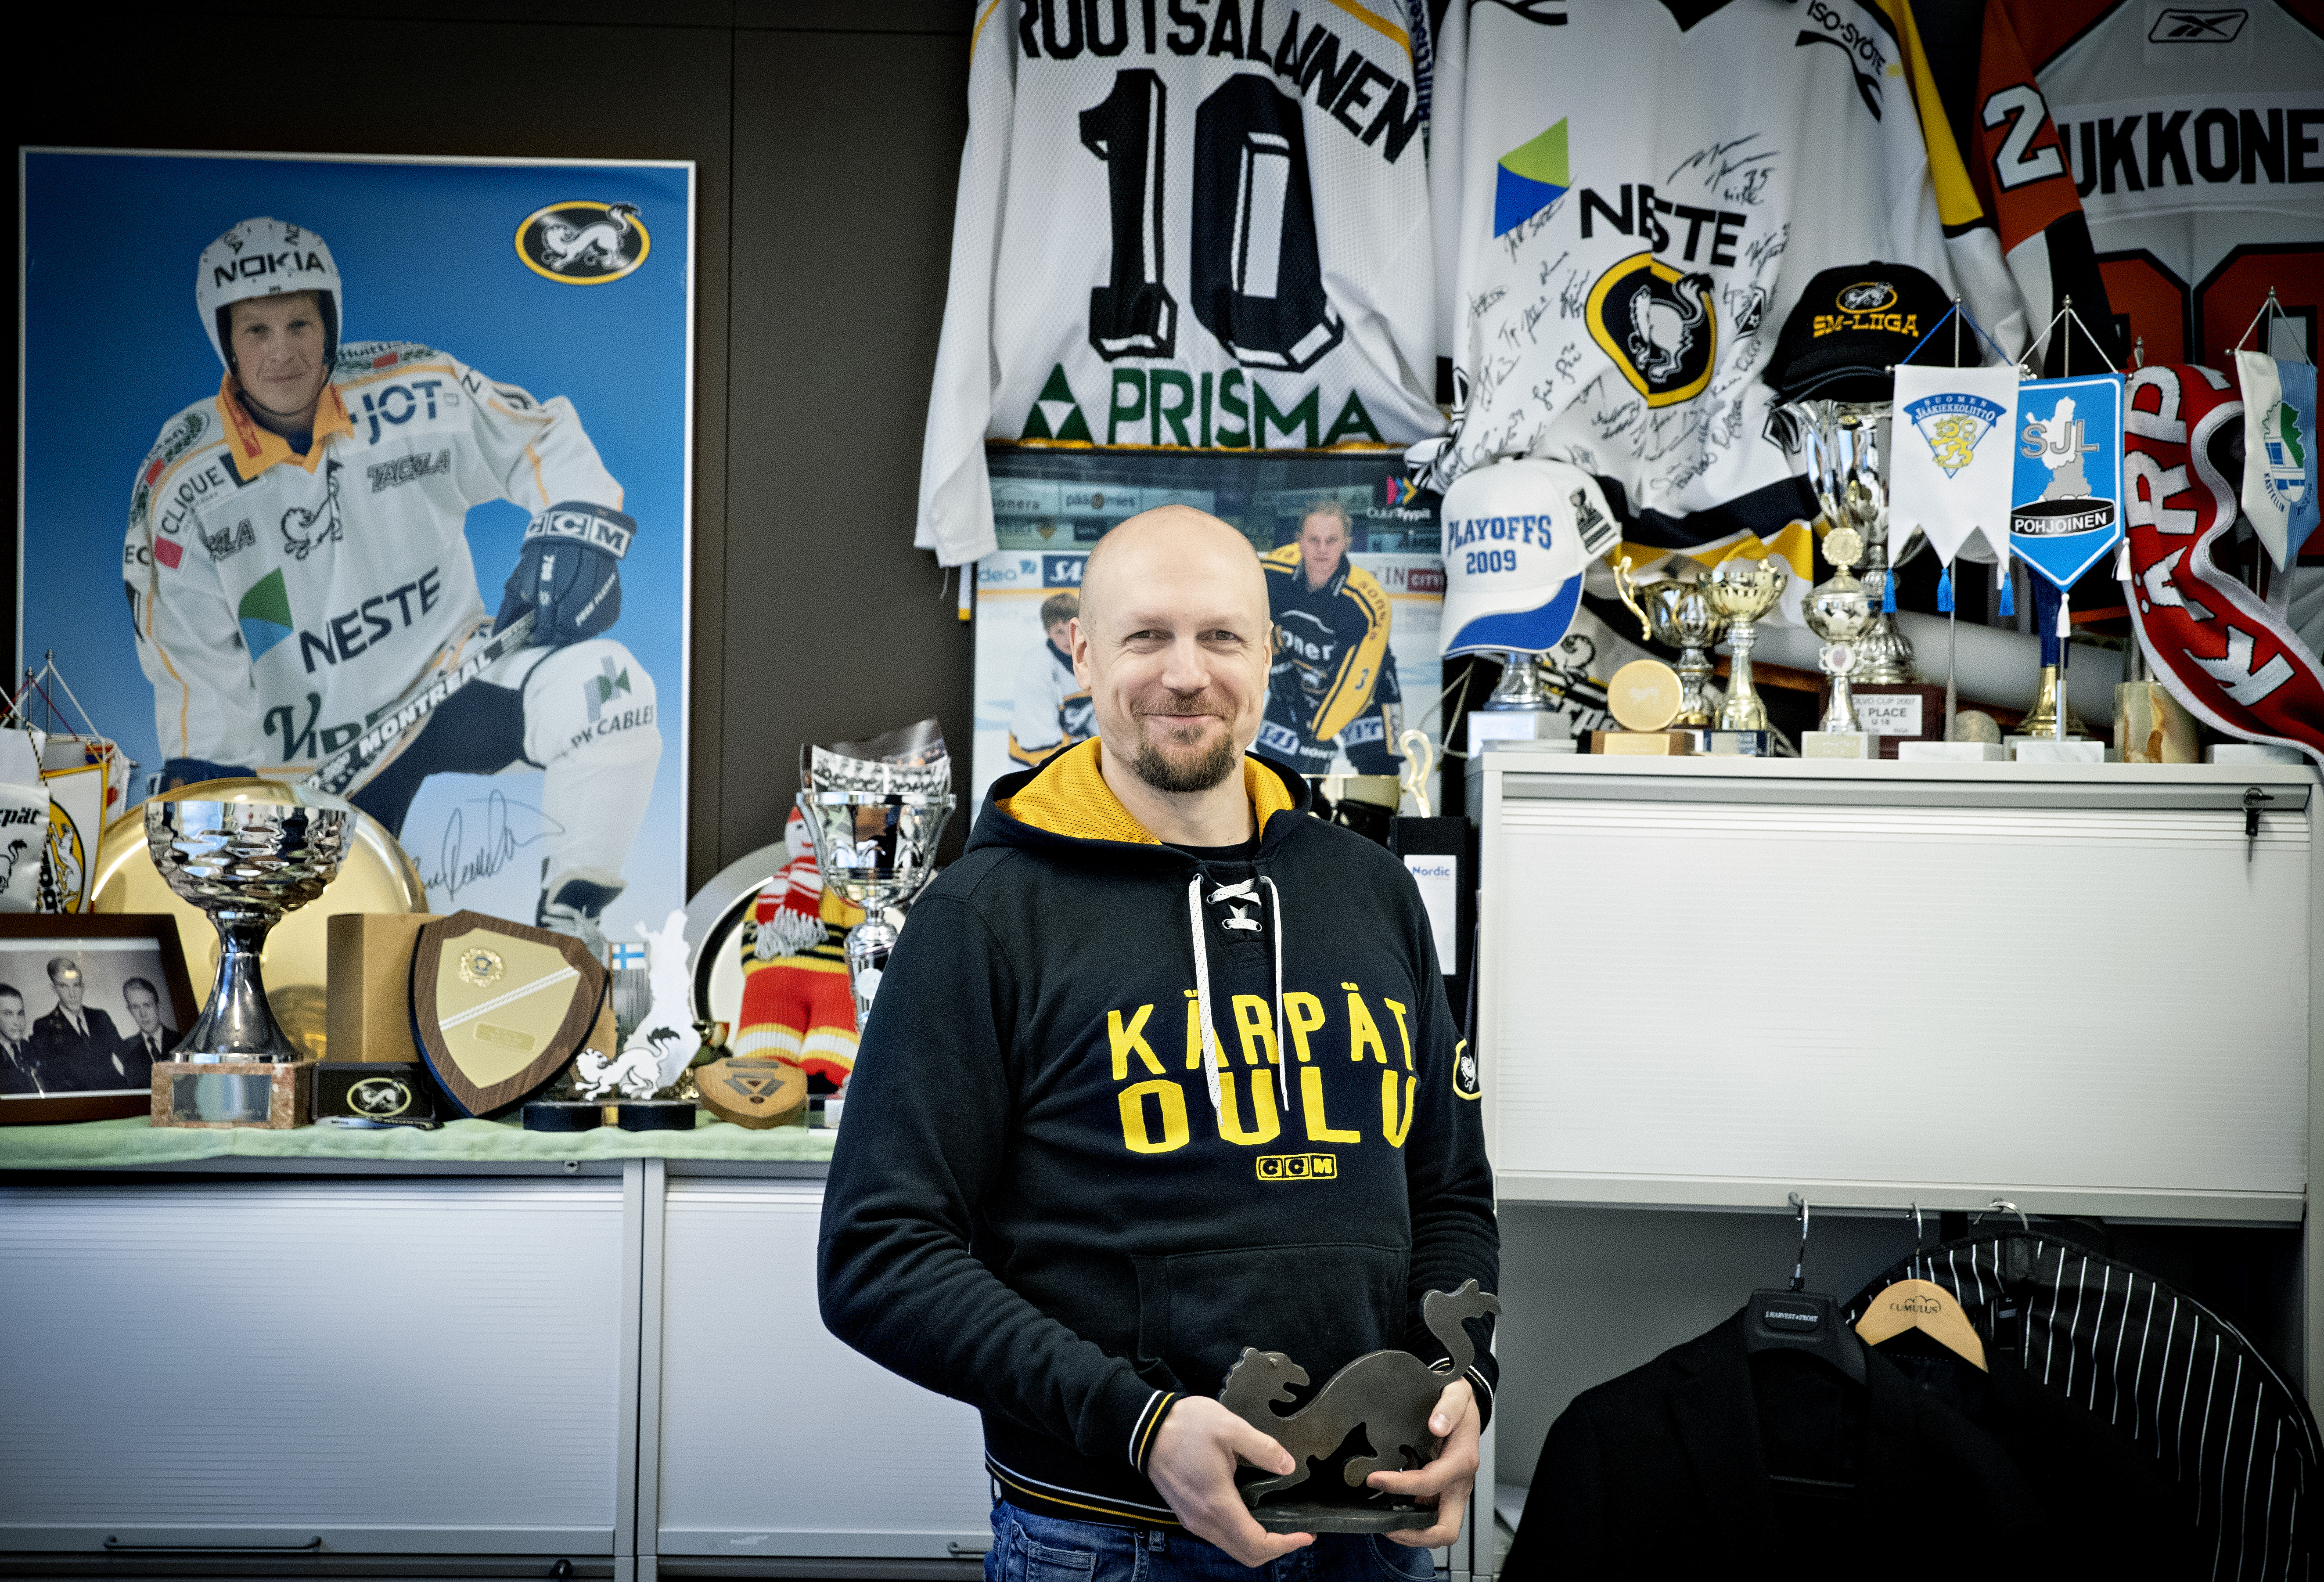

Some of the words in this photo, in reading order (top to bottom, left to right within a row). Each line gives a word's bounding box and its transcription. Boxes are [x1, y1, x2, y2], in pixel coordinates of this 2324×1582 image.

[1982, 83, 2068, 193] 2
[1079, 68, 1344, 372] 10
[213, 250, 325, 288] NOKIA
[1813, 314, 1919, 338] SM-LIIGA
[362, 380, 442, 445] JOT
[1107, 368, 1389, 448] PRISMA
[1924, 396, 1988, 407] SUOMEN
[2021, 420, 2099, 458] SJL
[161, 466, 225, 534] CLIQUE
[1448, 514, 1552, 557] PLAYOFFS
[2015, 512, 2107, 533] POHJOINEN
[1466, 550, 1517, 575] 2009
[299, 565, 440, 674] NESTE
[358, 653, 492, 757] MONTREAL
[1869, 708, 1907, 717] PLACE
[1412, 866, 1450, 876] Nordic
[1108, 982, 1414, 1080] KÄRPÄT
[1118, 1066, 1417, 1153] OULU
[1259, 1155, 1335, 1180] CCM
